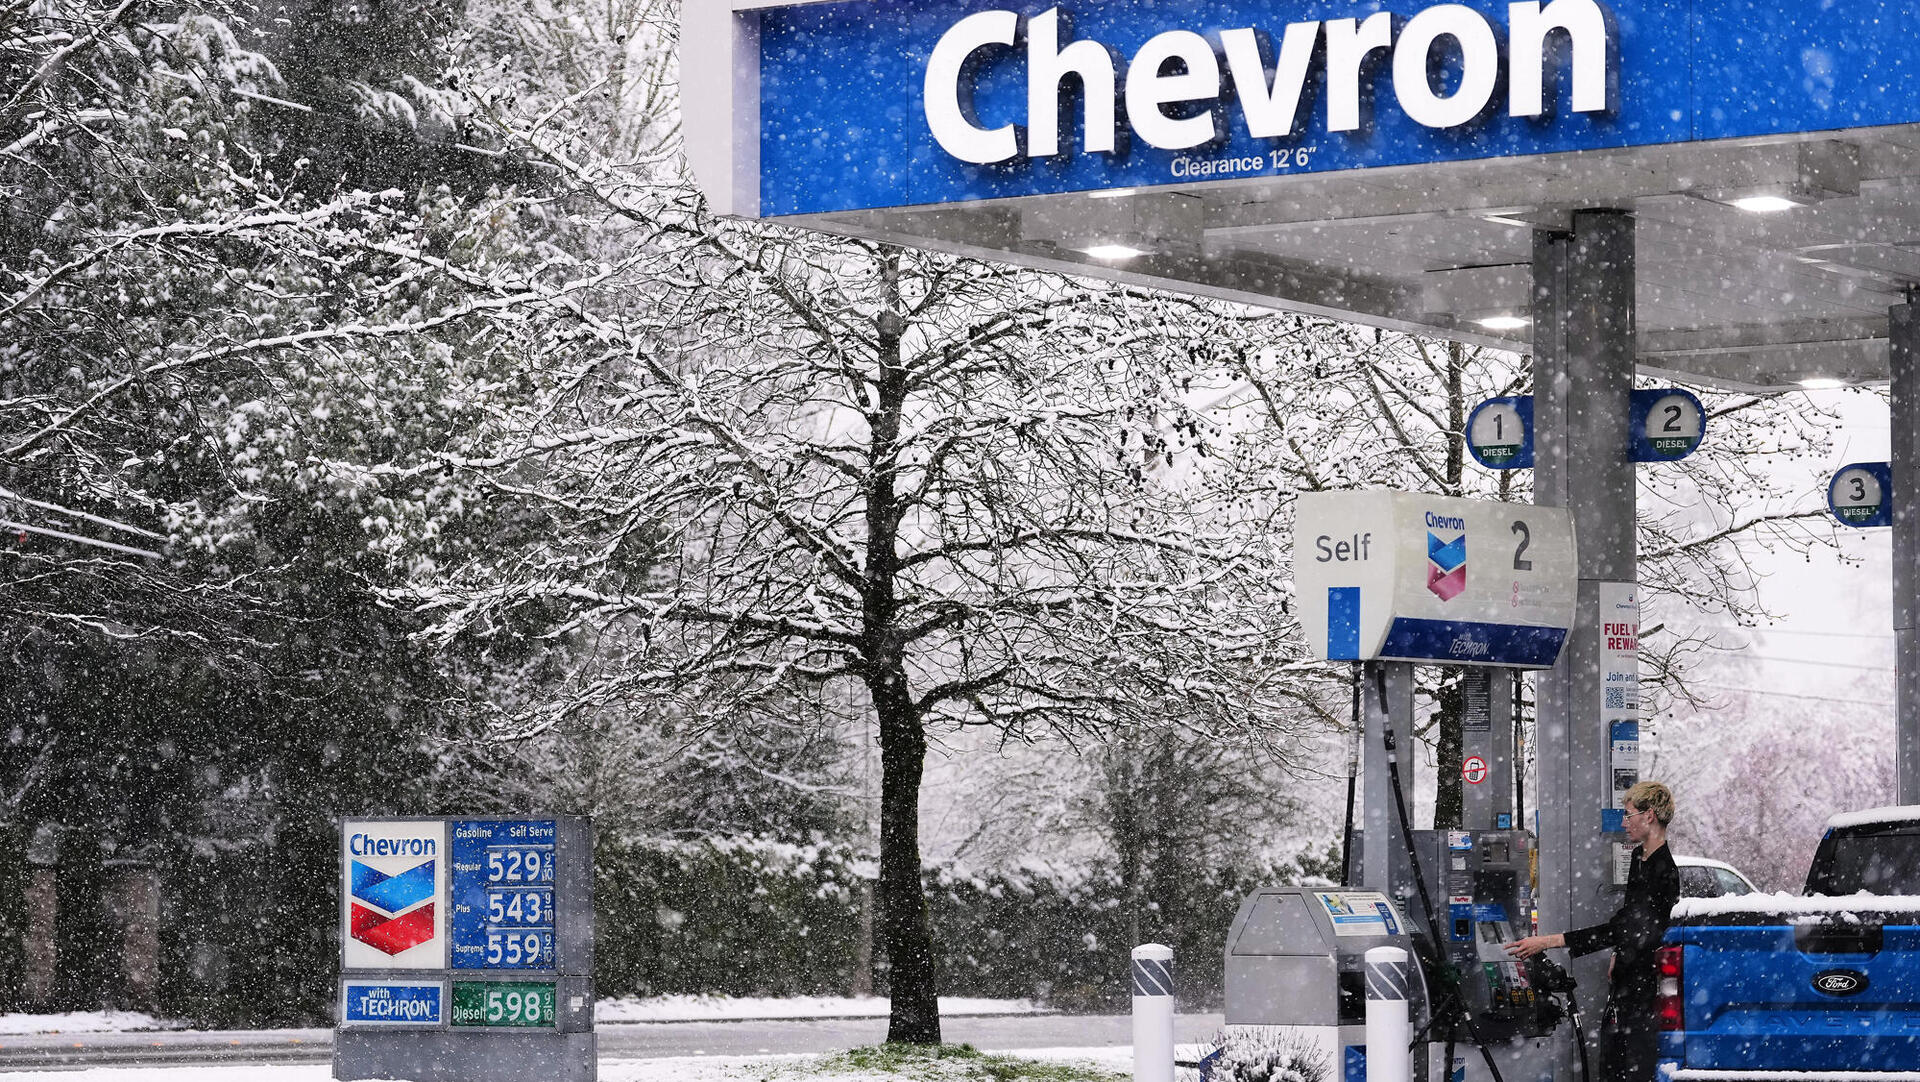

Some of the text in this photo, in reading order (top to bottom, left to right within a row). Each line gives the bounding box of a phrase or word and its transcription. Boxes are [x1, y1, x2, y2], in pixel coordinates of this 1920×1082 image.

[924, 0, 1606, 164] Chevron
[1170, 156, 1264, 177] Clearance
[1493, 413, 1503, 440] 1
[1662, 405, 1682, 432] 2
[1482, 446, 1513, 458] DIESEL
[1656, 439, 1687, 450] DIESEL
[1849, 478, 1866, 501] 3
[1425, 511, 1465, 531] Chevron
[1843, 506, 1871, 516] DIESEL
[1316, 533, 1371, 562] Self
[1511, 520, 1532, 571] 2
[1604, 623, 1630, 636] FUEL
[1606, 672, 1624, 682] Join
[456, 827, 554, 838] Gasoline Self Serve
[350, 833, 436, 856] Chevron
[455, 862, 481, 872] Regular
[488, 851, 541, 881] 529
[456, 904, 471, 913] Plus
[489, 893, 541, 923] 543
[455, 944, 484, 954] Supreme
[488, 934, 541, 964] 559
[369, 988, 391, 999] with
[1825, 977, 1849, 989] Ford
[360, 996, 430, 1020] TECHRON
[453, 1006, 483, 1020] Diesel
[488, 992, 541, 1021] 598
